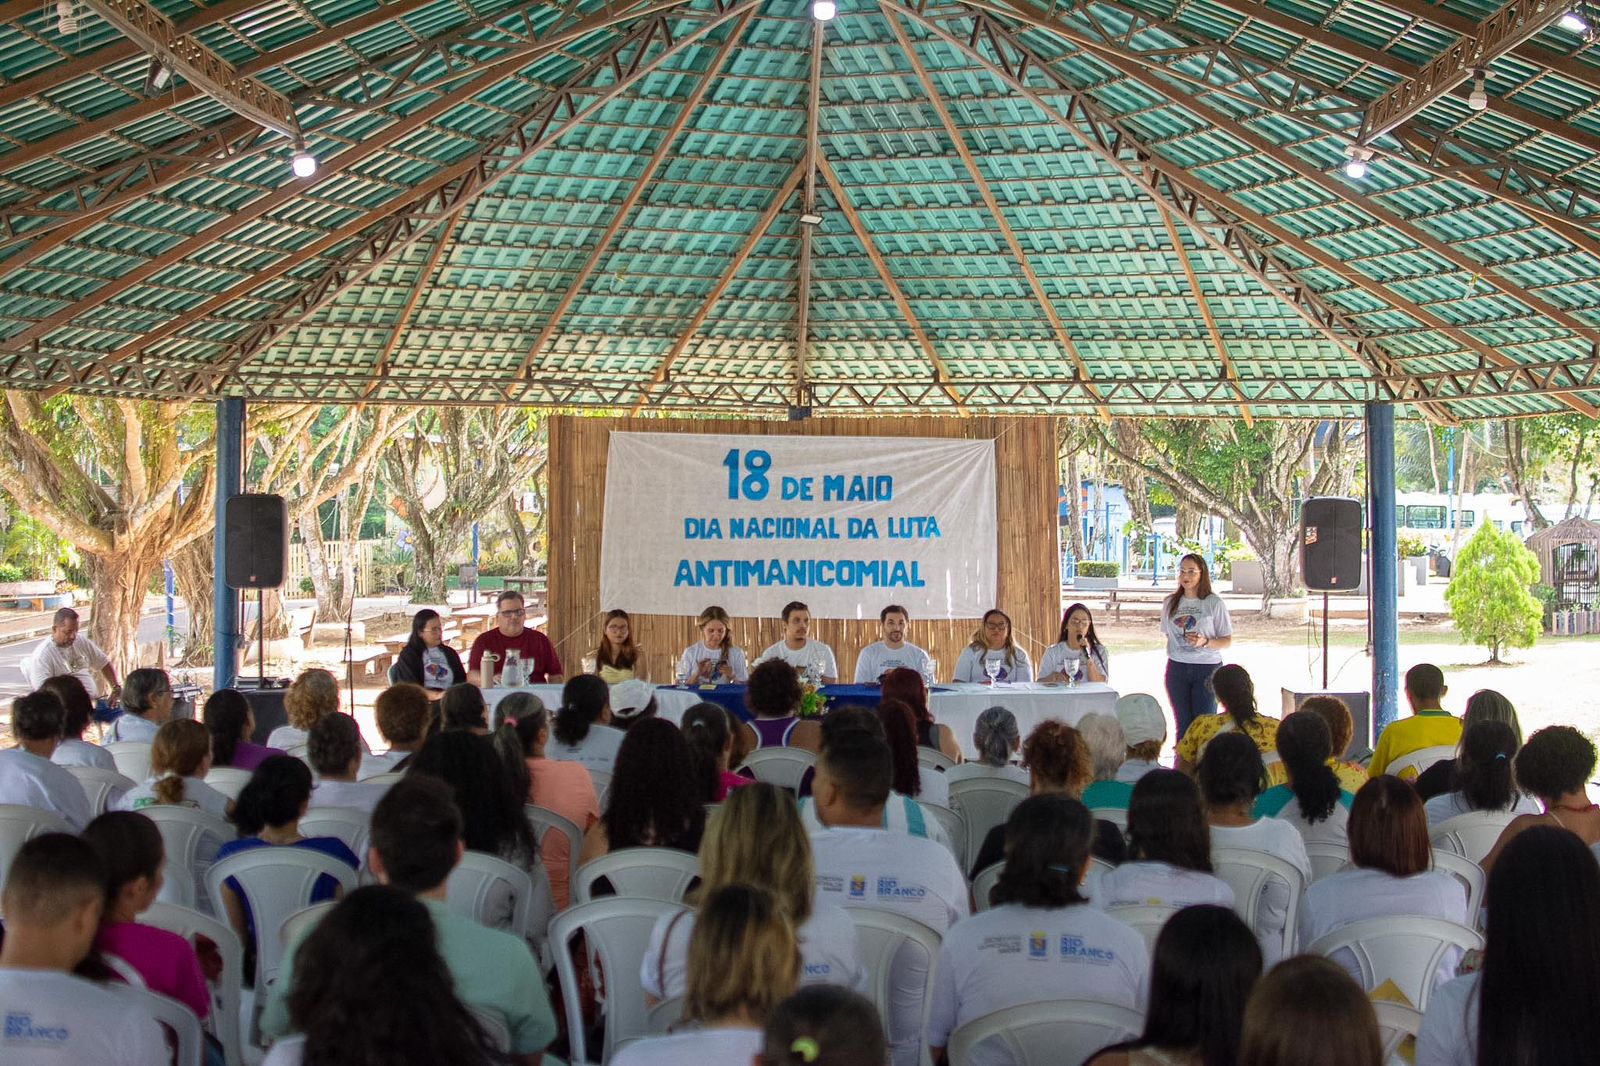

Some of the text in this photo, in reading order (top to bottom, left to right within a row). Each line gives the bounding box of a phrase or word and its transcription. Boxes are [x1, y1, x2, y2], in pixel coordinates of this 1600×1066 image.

[723, 448, 893, 502] 18 DE MAIO
[684, 516, 942, 540] DIA NACIONAL DA LUTA
[674, 559, 926, 588] ANTIMANICOMIAL
[877, 887, 926, 897] BRANCO
[1061, 946, 1115, 960] BRANCO
